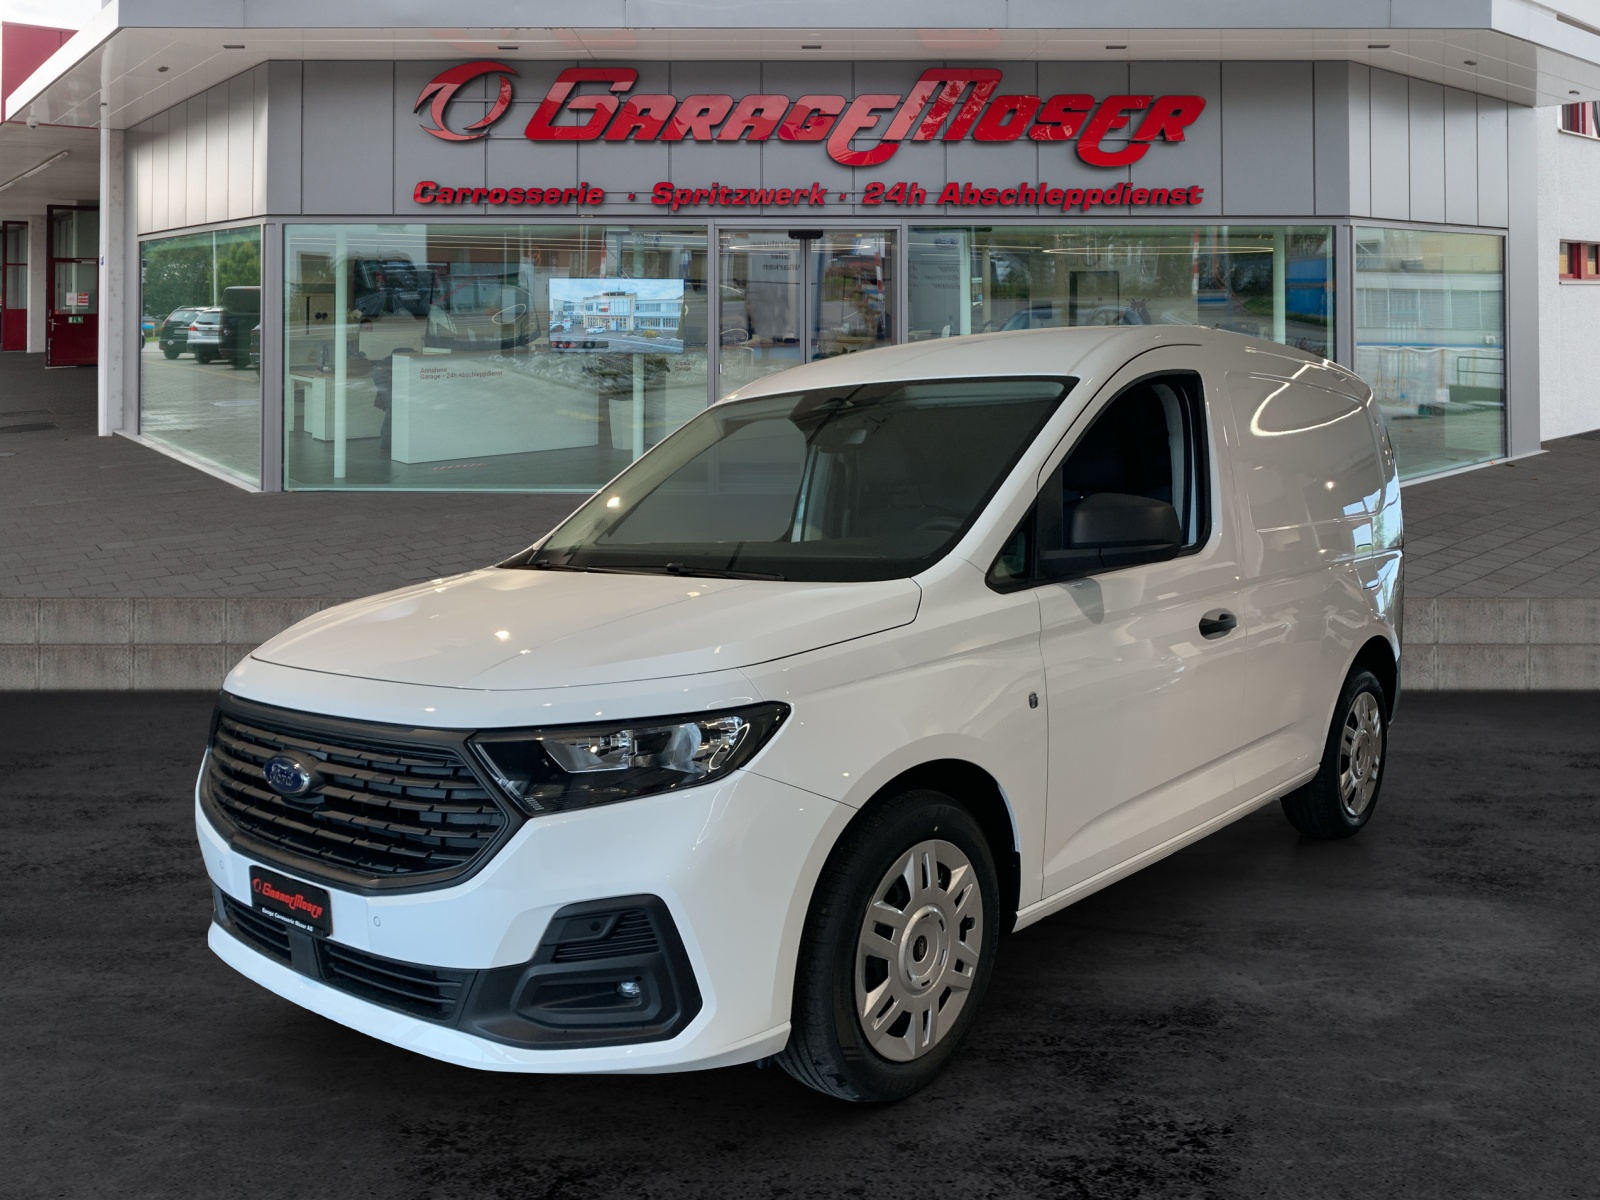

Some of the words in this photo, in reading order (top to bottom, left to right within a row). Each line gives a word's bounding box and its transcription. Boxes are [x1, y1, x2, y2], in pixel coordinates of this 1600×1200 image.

[413, 181, 604, 205] Carrosserie
[651, 181, 825, 211] Spritzwerk
[862, 182, 926, 205] 24h
[937, 182, 1204, 211] Abschleppdienst
